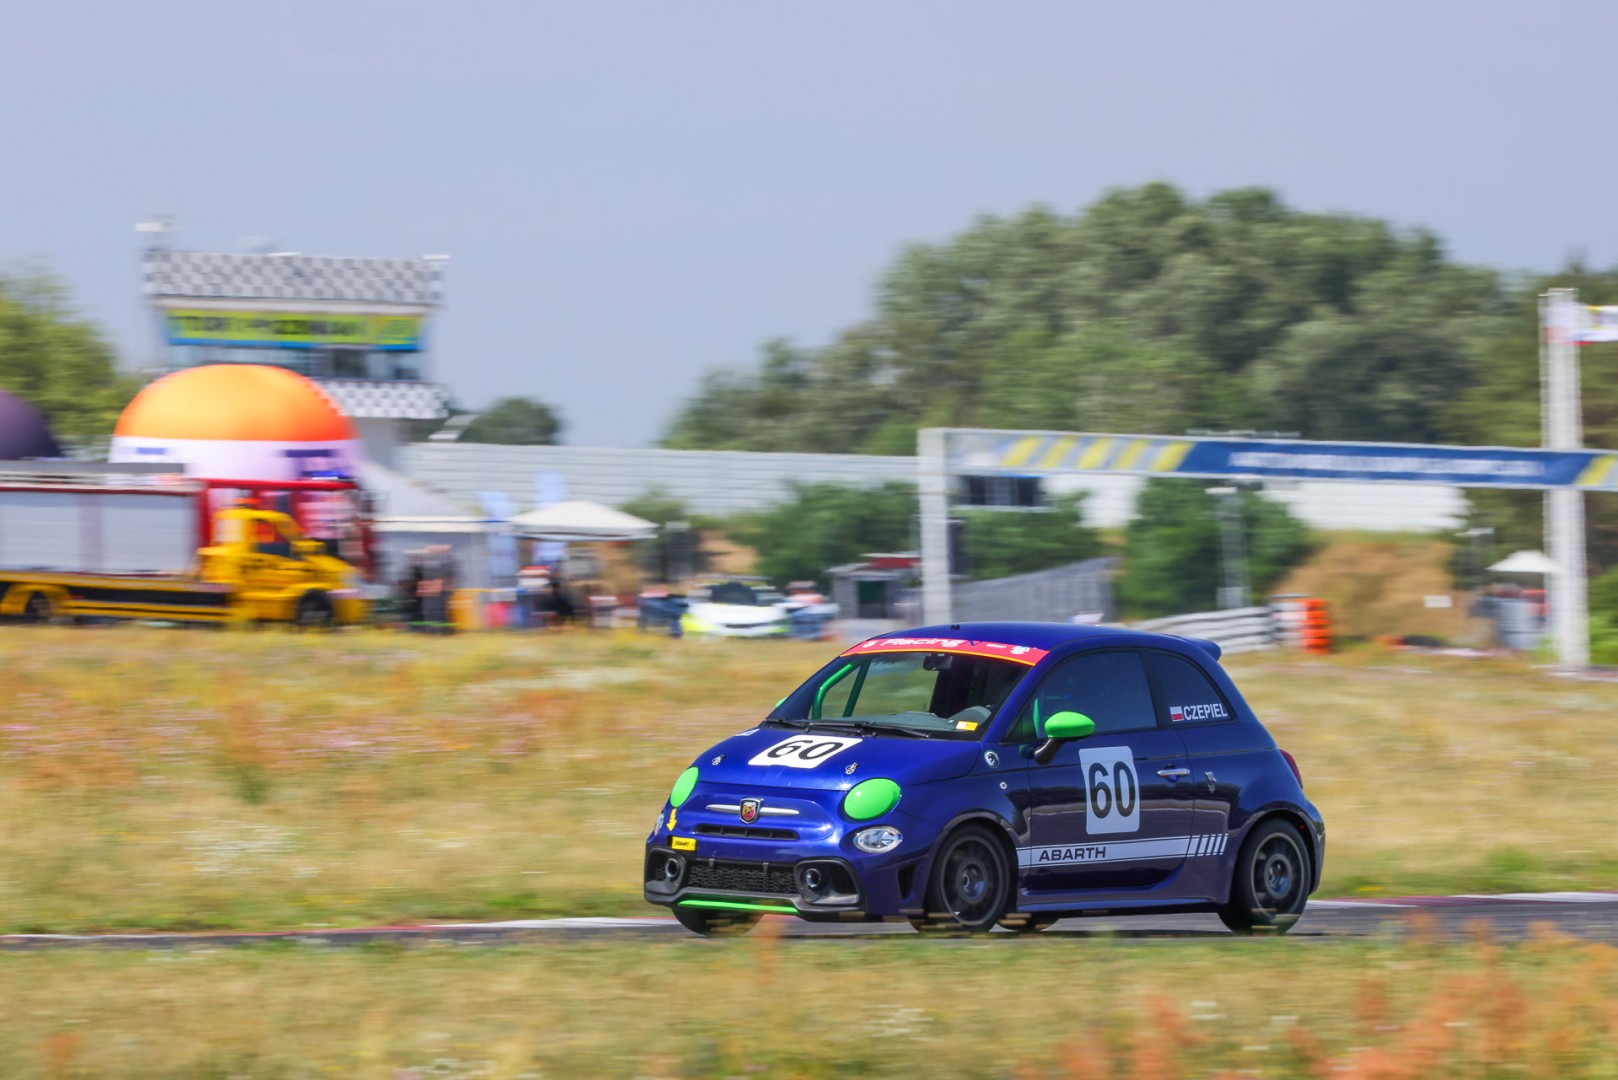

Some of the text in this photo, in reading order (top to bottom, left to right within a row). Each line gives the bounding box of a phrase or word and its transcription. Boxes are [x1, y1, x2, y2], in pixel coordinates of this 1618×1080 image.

[880, 638, 964, 648] Racing
[1183, 703, 1228, 720] CZEPIEL
[767, 740, 844, 760] 60
[1088, 761, 1135, 819] 60
[1038, 846, 1106, 862] ABARTH
